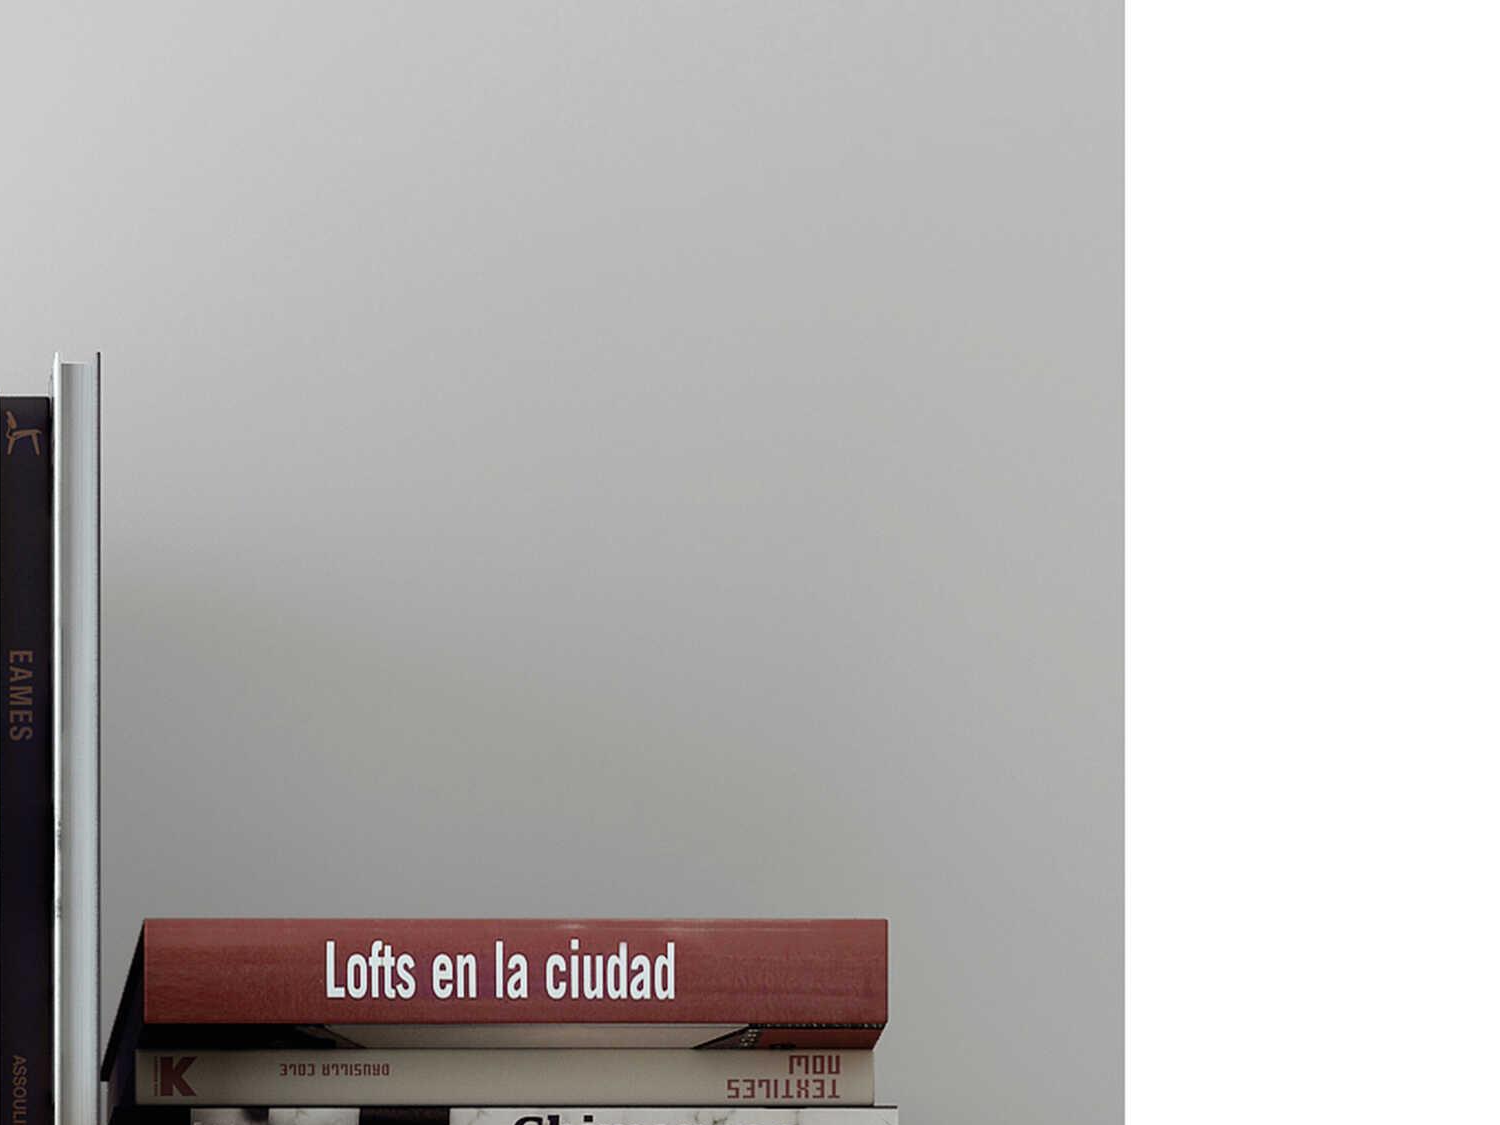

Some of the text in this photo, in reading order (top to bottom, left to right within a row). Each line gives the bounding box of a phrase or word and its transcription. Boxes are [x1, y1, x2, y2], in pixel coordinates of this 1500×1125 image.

[9, 650, 33, 740] EAMES
[327, 939, 674, 999] Lofts en la ciudad
[160, 1056, 198, 1096] K
[280, 1064, 389, 1076] DRUSILLA COLE
[728, 1079, 839, 1098] TEXTILES
